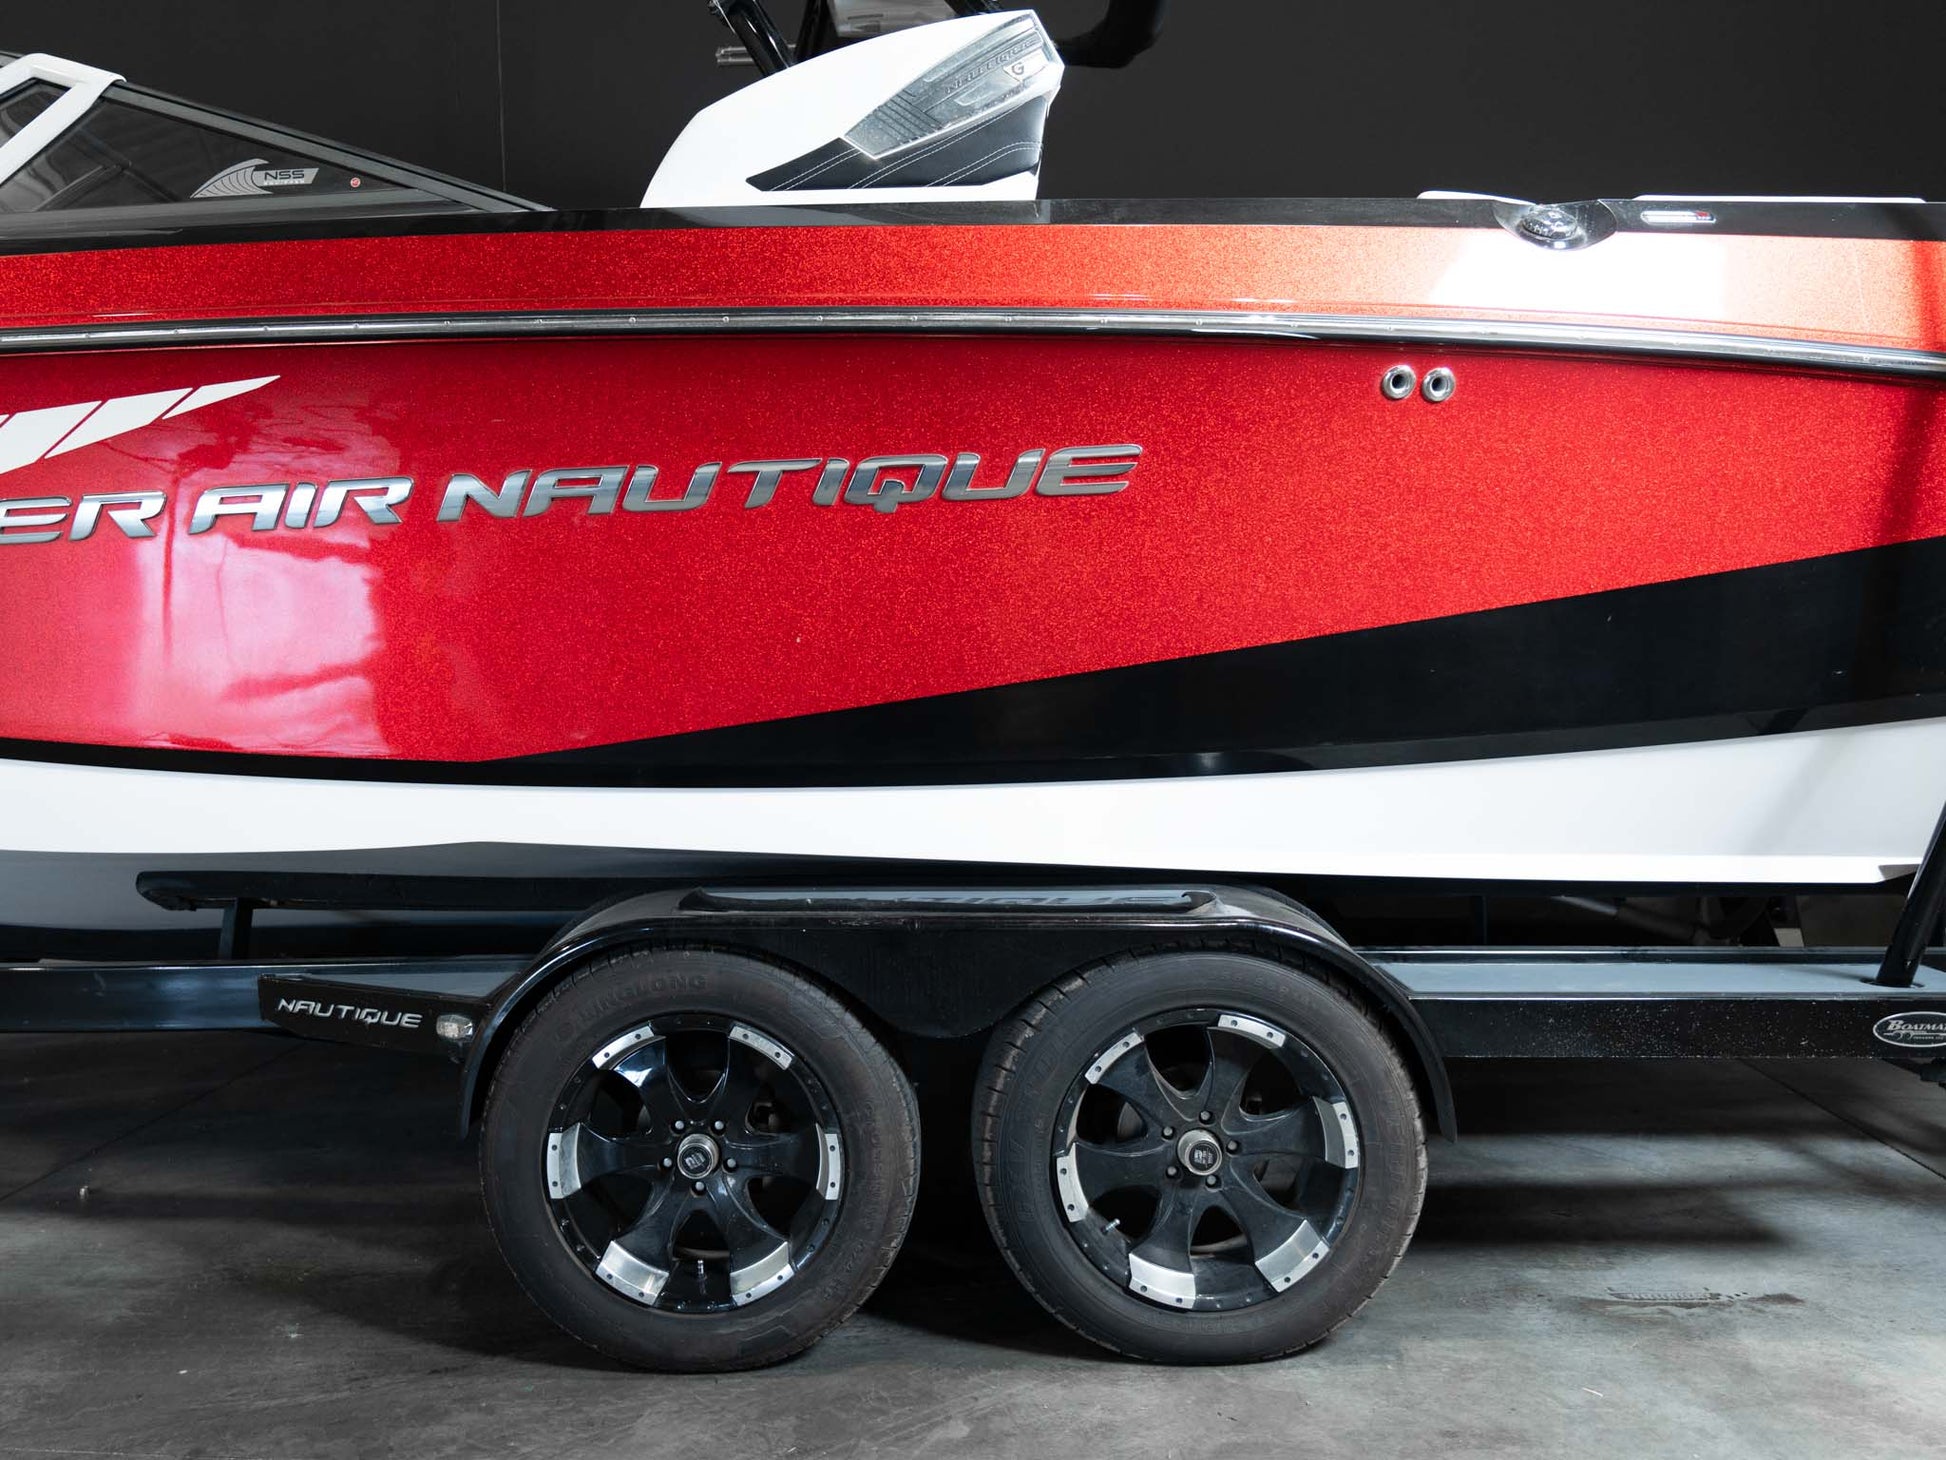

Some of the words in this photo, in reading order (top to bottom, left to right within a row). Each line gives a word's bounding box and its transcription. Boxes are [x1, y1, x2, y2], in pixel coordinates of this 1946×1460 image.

[264, 169, 305, 181] NSS
[188, 476, 415, 535] AIR
[437, 444, 1143, 522] NAUTIQUE
[277, 998, 423, 1029] NAUTIQUE
[1887, 1020, 1946, 1031] BOATMA
